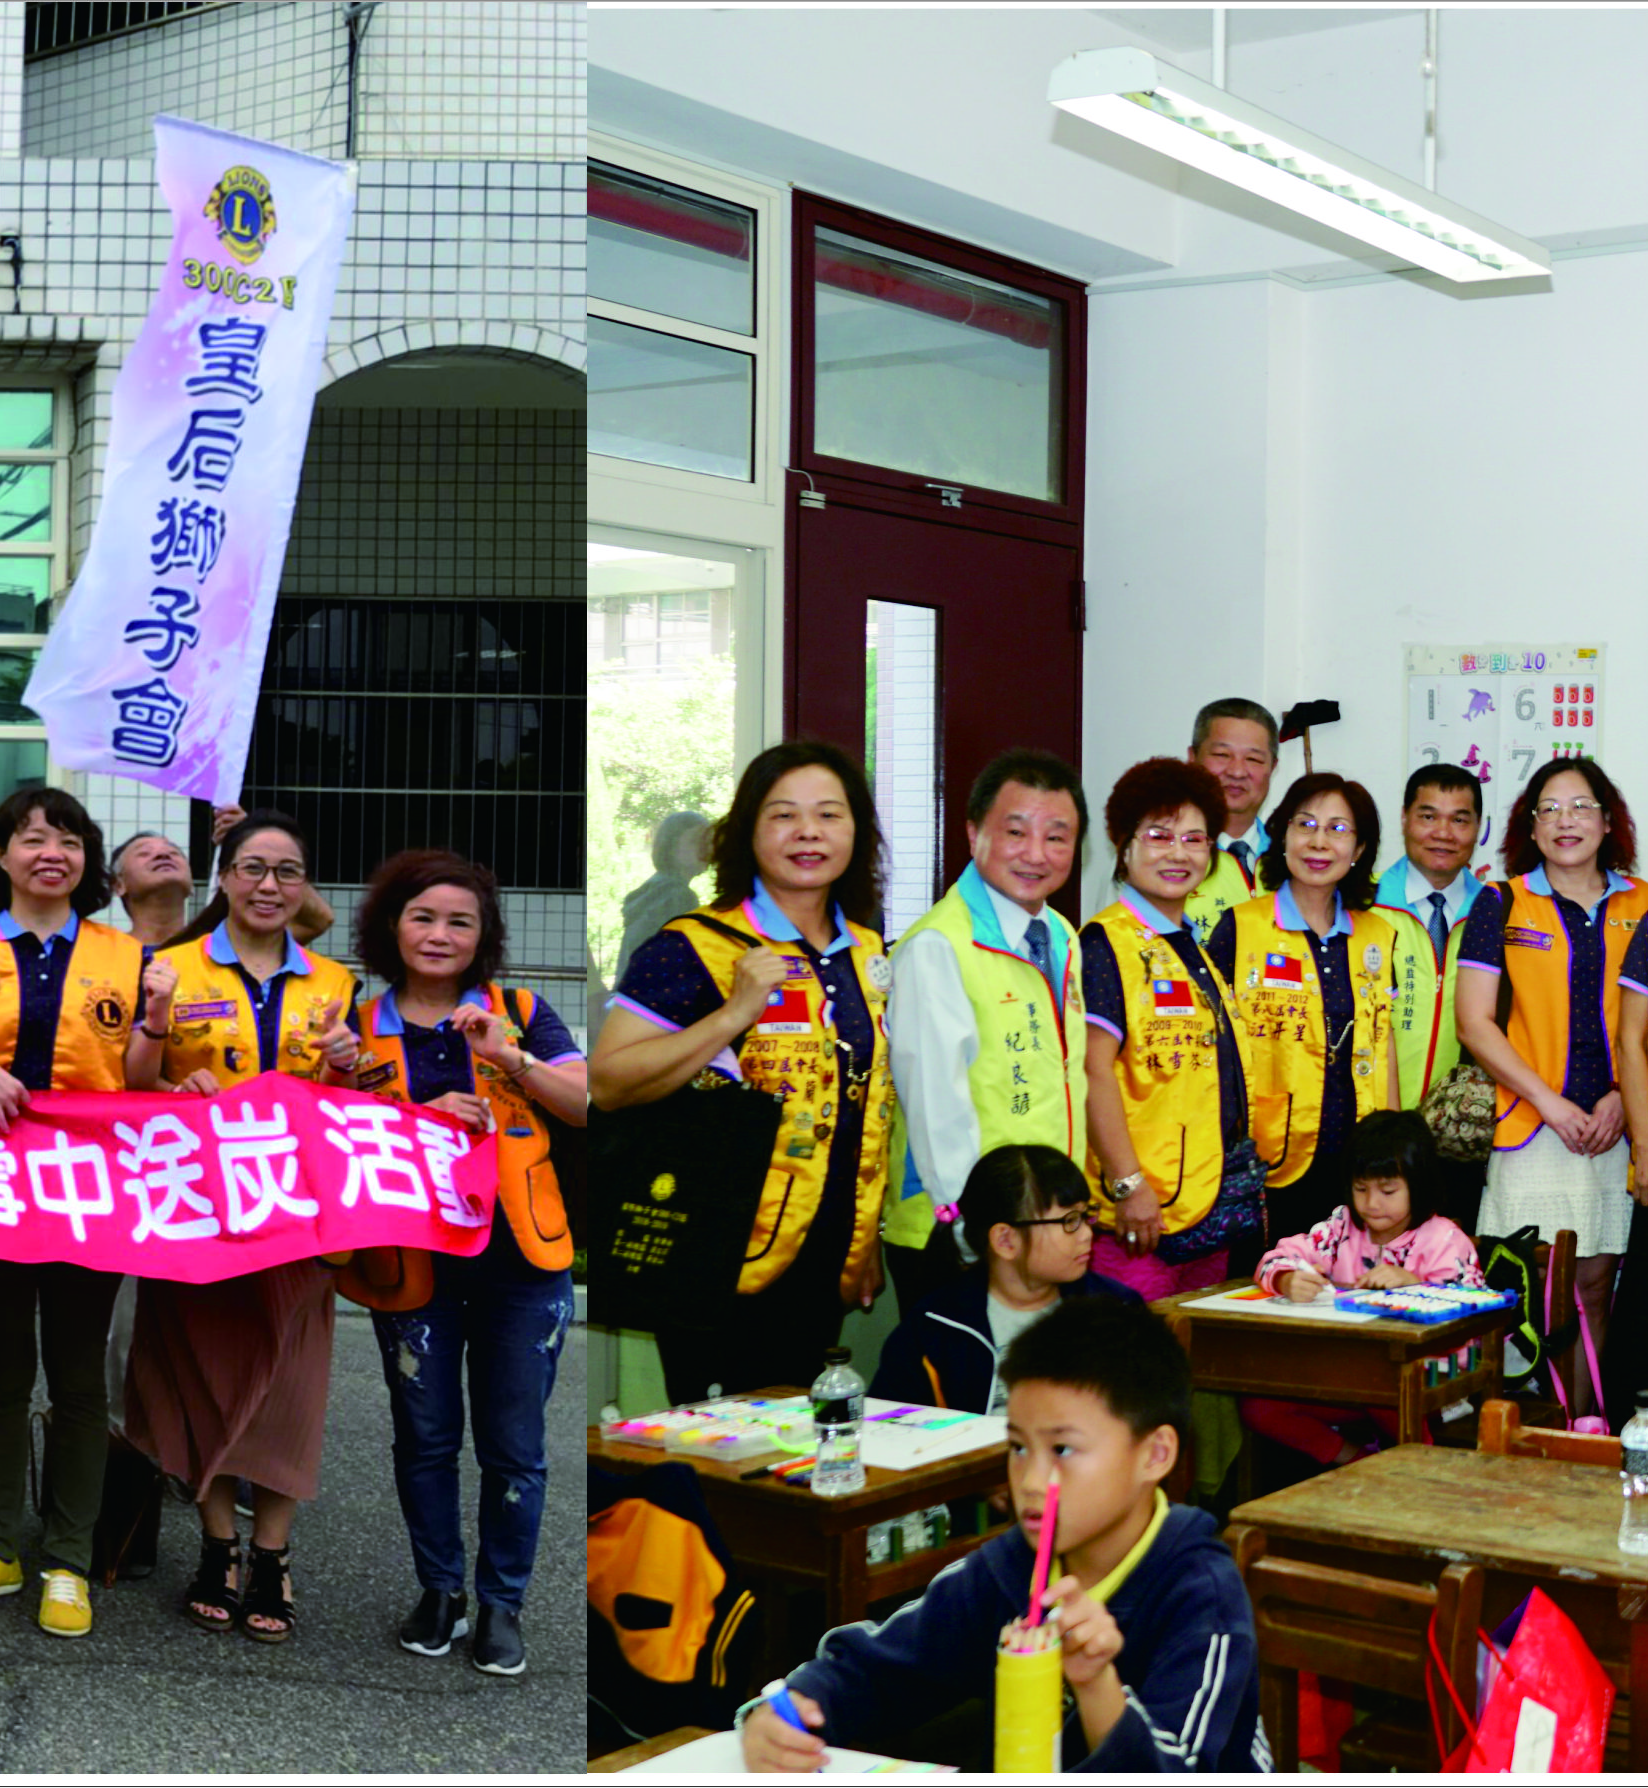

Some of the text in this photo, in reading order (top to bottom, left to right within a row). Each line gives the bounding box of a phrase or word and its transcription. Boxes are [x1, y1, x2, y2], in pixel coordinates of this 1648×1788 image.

[232, 195, 253, 237] L
[111, 316, 268, 769] 皇后獅子會
[1514, 687, 1536, 720] 6
[1511, 749, 1535, 781] 7
